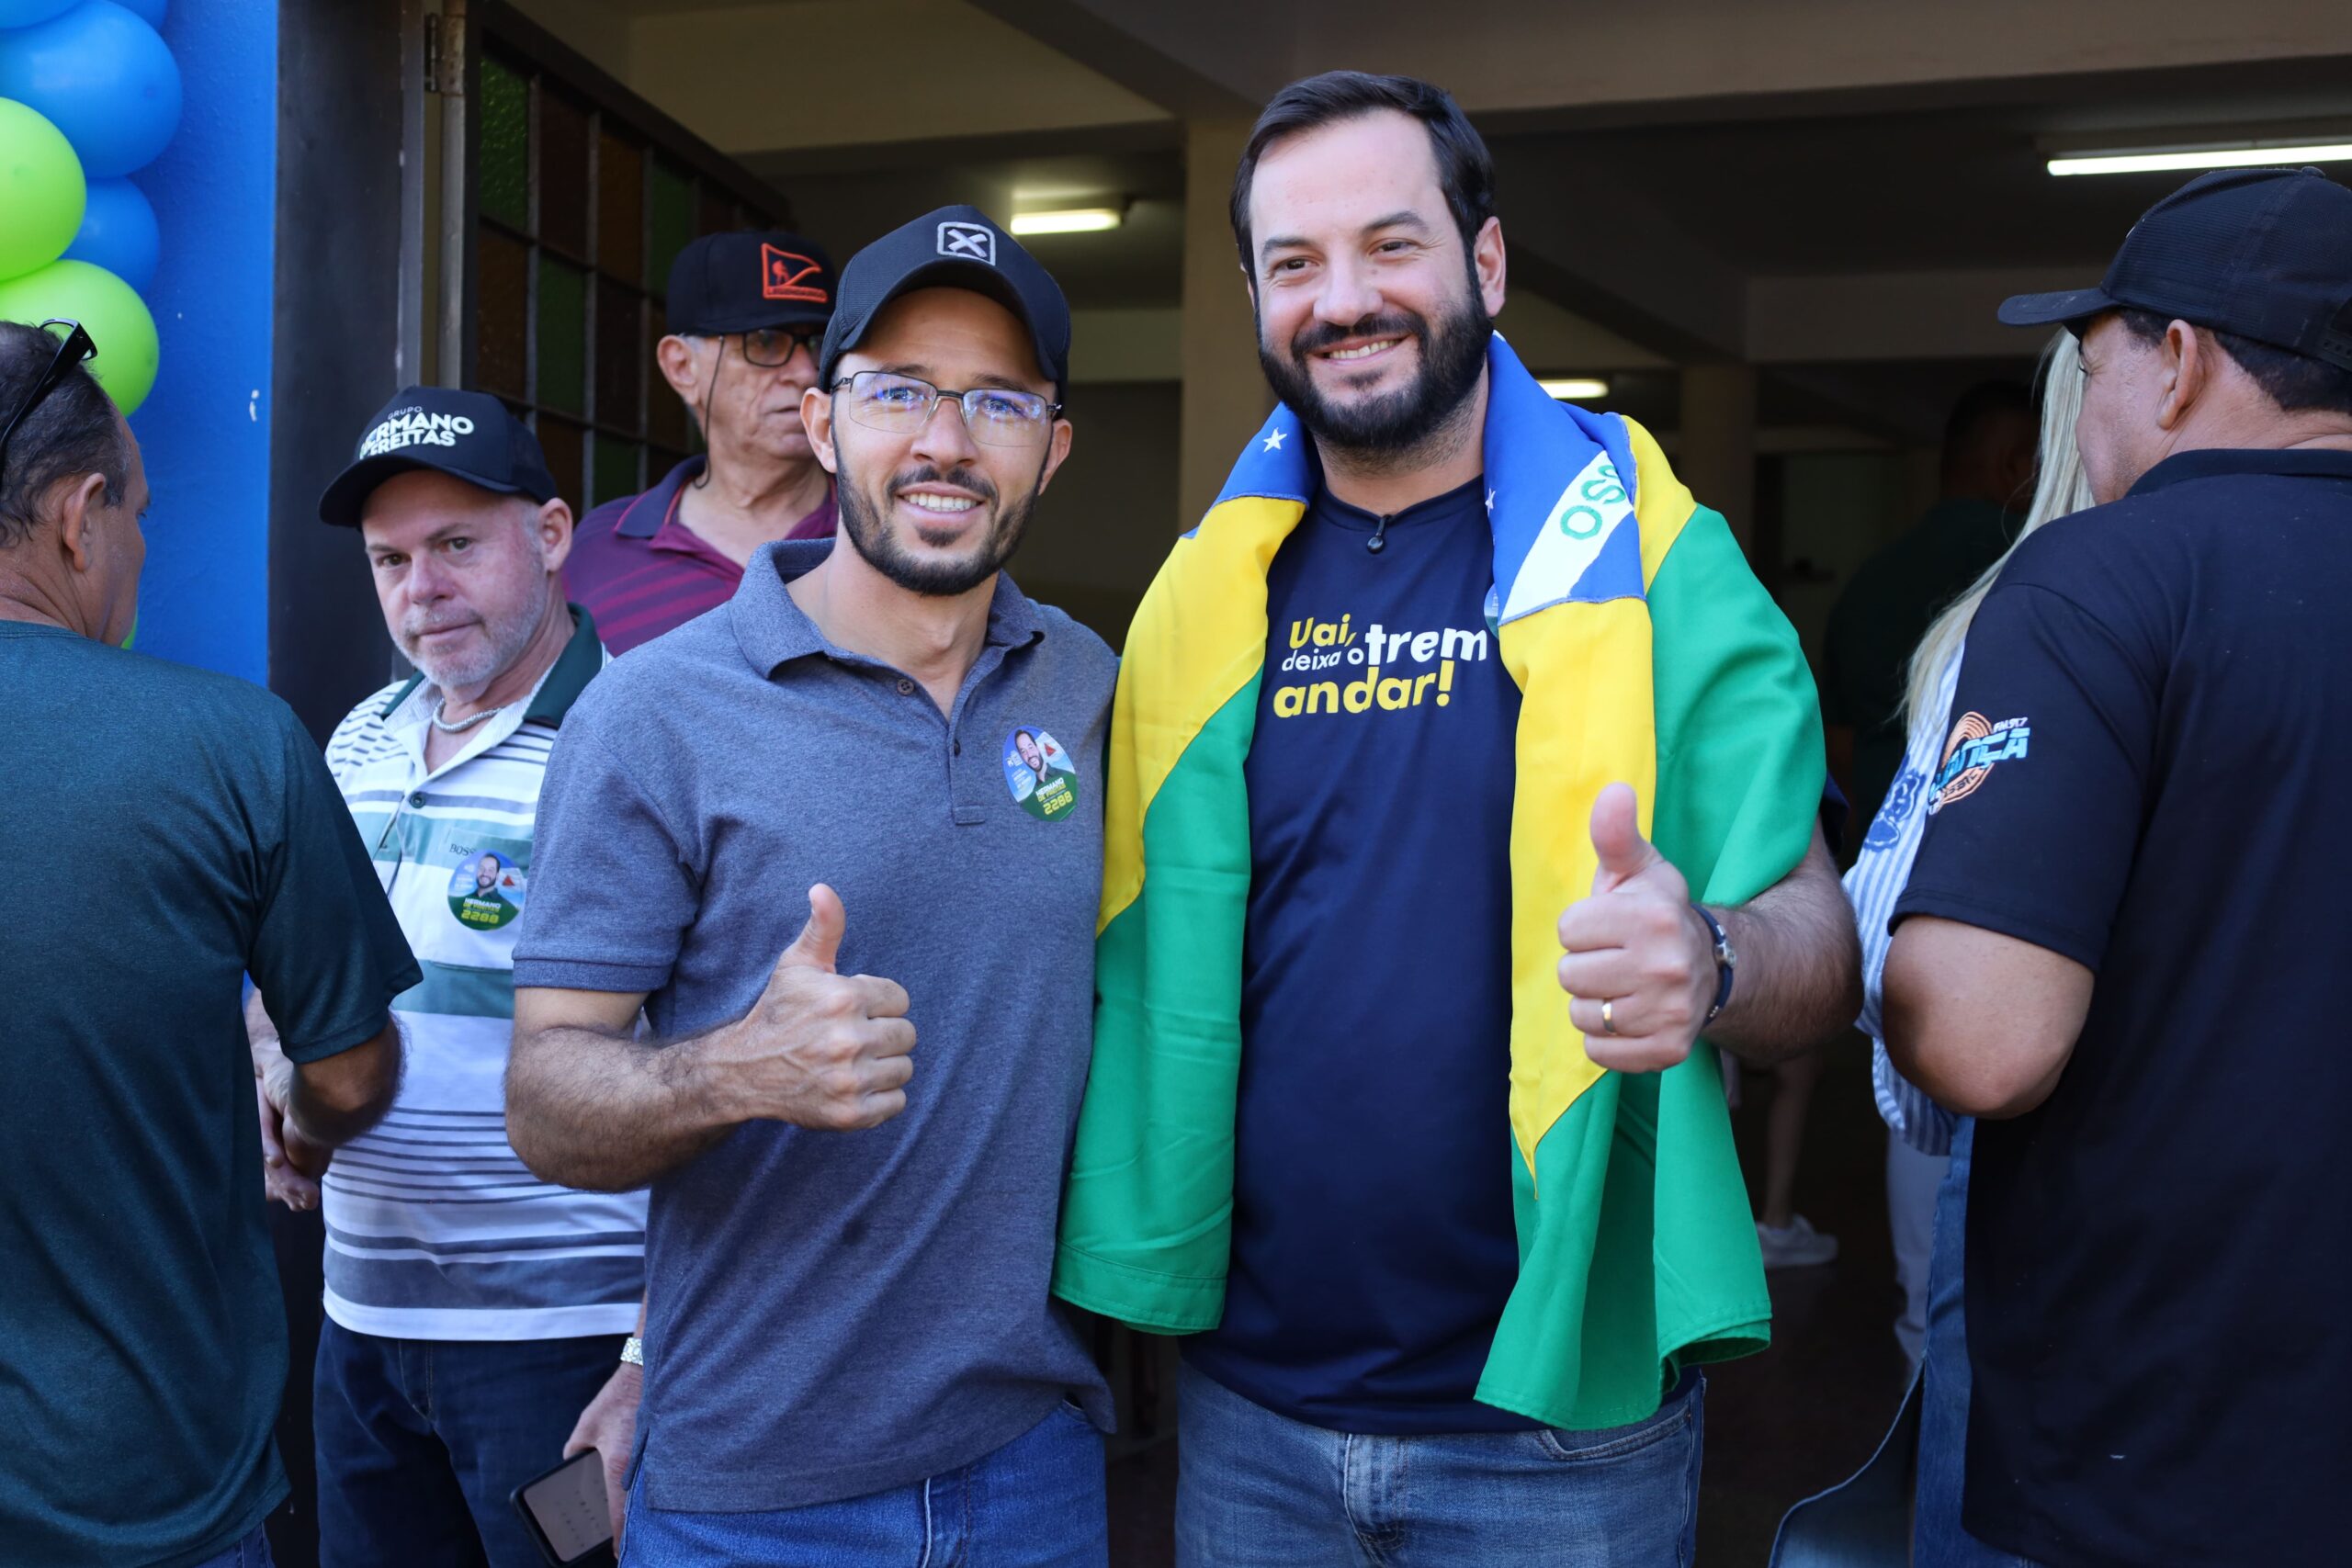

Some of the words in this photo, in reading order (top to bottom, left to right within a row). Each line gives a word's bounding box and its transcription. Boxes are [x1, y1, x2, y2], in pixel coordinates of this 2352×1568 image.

[388, 406, 423, 420] GRUPO
[1282, 648, 1341, 671] deixa
[1347, 648, 1364, 665] o
[1364, 624, 1487, 665] trem
[1273, 660, 1454, 718] andar!
[1043, 791, 1073, 815] 2288
